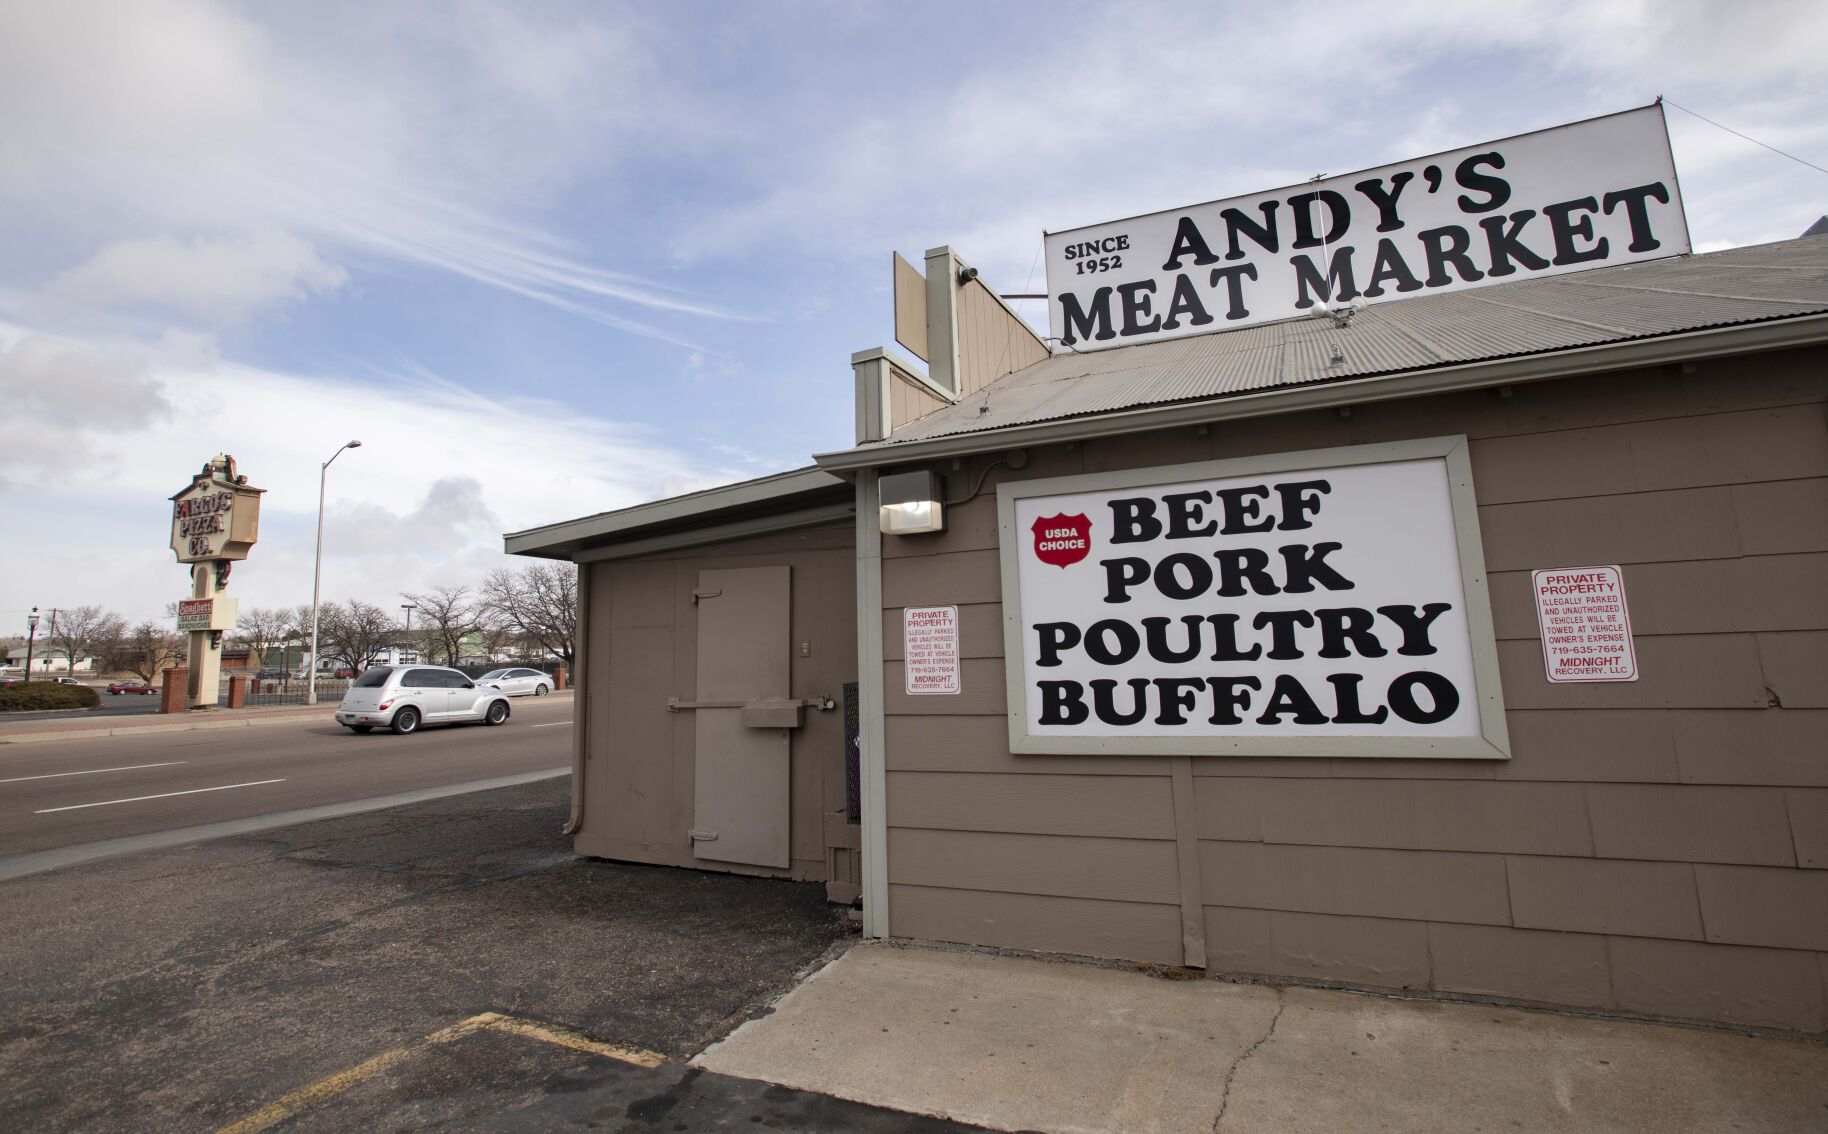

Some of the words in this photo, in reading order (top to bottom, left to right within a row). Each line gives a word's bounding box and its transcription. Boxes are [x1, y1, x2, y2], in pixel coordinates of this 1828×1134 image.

[1162, 151, 1512, 272] ANDY'S
[1064, 235, 1130, 261] SINCE
[1058, 262, 1258, 347] MEAT
[1290, 181, 1670, 310] MARKET
[1076, 256, 1123, 275] 1952
[174, 491, 233, 518] FARGO'S
[1108, 479, 1332, 545] BEEF
[179, 514, 224, 538] PIZZA
[1045, 527, 1078, 539] USDA
[189, 537, 213, 555] CO.
[1039, 539, 1085, 551] CHOICE
[1100, 541, 1355, 604] PORK
[1546, 573, 1607, 585] PRIVATE
[1541, 583, 1615, 595] PROPERTY
[1542, 597, 1582, 606] ILLEGALLY
[1586, 595, 1618, 604] PARKED
[179, 601, 213, 616] Spaghetti
[1544, 607, 1560, 615] AND
[1562, 604, 1620, 615] UNAUTHORIZED
[181, 615, 198, 623] SALAD
[912, 611, 949, 619] PRIVATE
[1550, 616, 1584, 625] VEHICLES
[1586, 614, 1605, 623] WILL
[1606, 614, 1617, 622] BE
[908, 619, 953, 627] PROPERTY
[1547, 626, 1574, 635] TOWED
[1578, 625, 1587, 633] AT
[1590, 623, 1624, 633] VEHICLE
[919, 635, 955, 643] UNAUTHORIZED
[1032, 602, 1452, 667] POULTRY
[1548, 635, 1584, 644] OWNER'S
[1587, 633, 1625, 643] EXPENSE
[1552, 645, 1624, 654] 719-635-7664
[1560, 656, 1622, 667] MIDNIGHT
[1610, 666, 1628, 674] LLC
[914, 675, 953, 683] MIDNIGHT
[1037, 671, 1460, 726] BUFFALO
